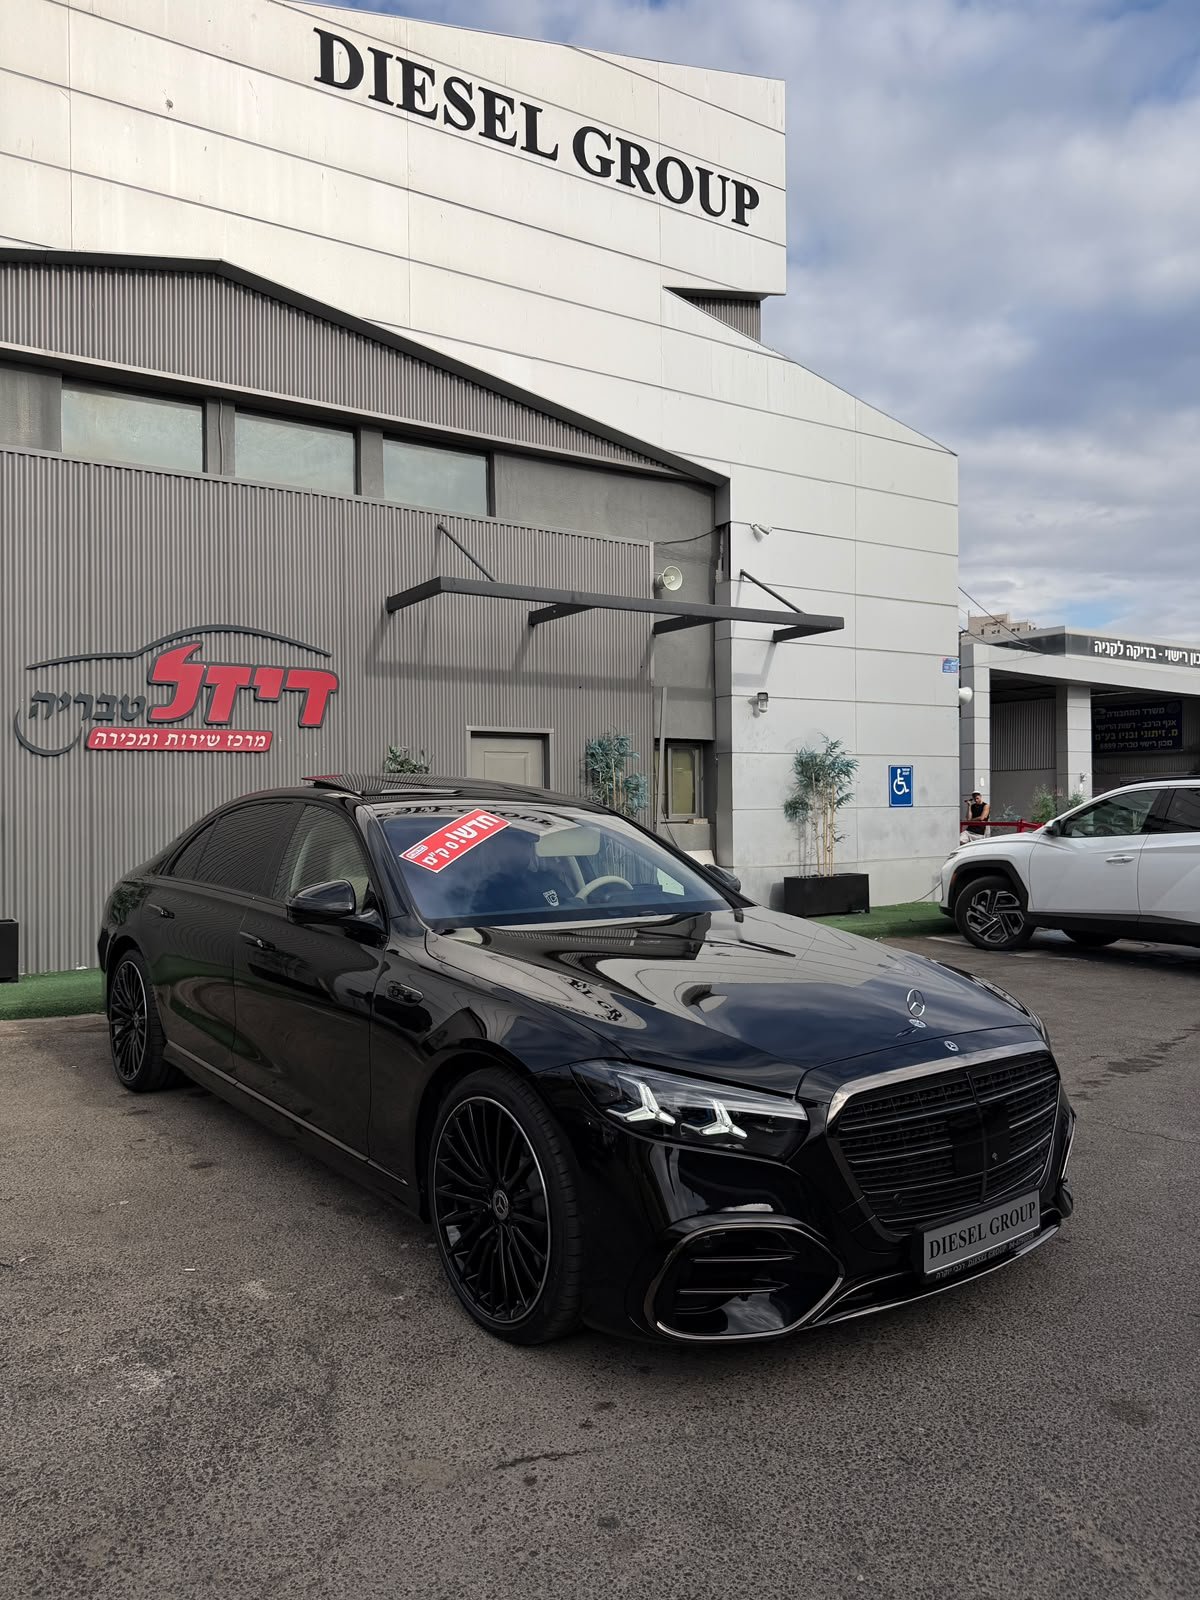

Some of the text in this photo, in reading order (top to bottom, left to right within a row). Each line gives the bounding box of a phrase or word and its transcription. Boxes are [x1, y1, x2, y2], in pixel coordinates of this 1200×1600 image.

[313, 27, 760, 228] DIESEL GROUP
[1094, 640, 1124, 657] לקניה
[1126, 644, 1157, 660] בדיקה
[1165, 649, 1188, 663] רישוי
[28, 640, 340, 728] דיזל טבריה
[1142, 707, 1165, 716] משרד
[94, 731, 267, 748] מרכז שירות ומכירה
[444, 814, 499, 844] חדש!
[928, 1223, 987, 1260] DIESEL
[989, 1201, 1036, 1236] GROUP
